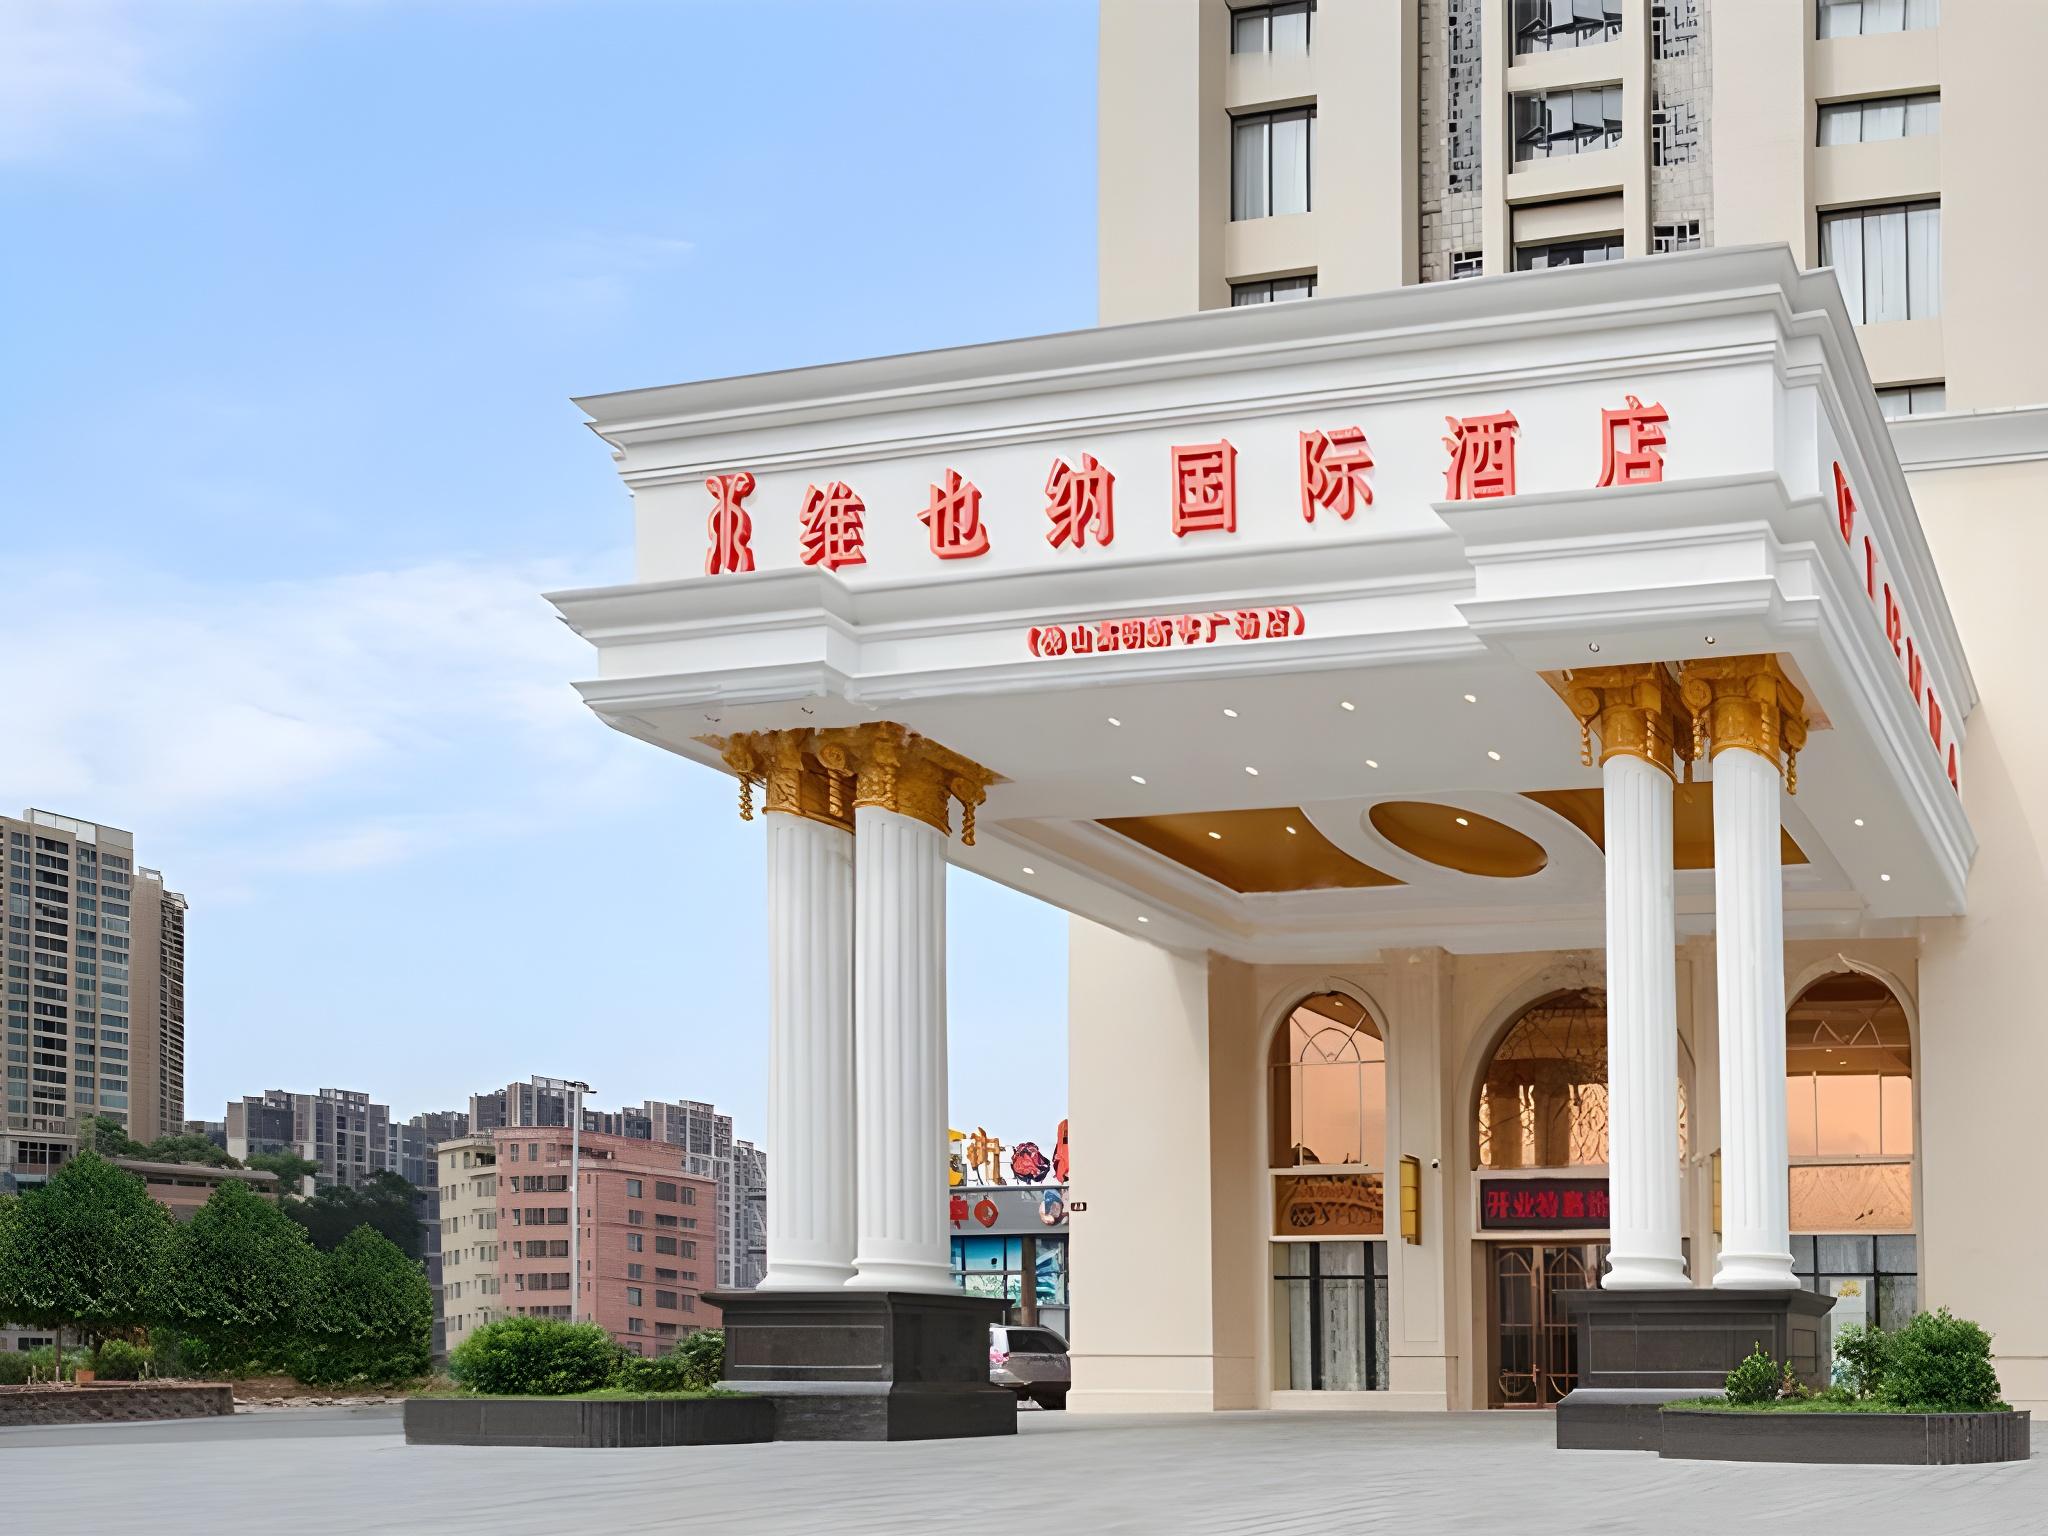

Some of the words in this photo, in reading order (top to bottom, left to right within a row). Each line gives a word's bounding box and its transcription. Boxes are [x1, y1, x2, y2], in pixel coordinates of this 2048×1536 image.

[799, 395, 1669, 570] 维也纳国际酒店
